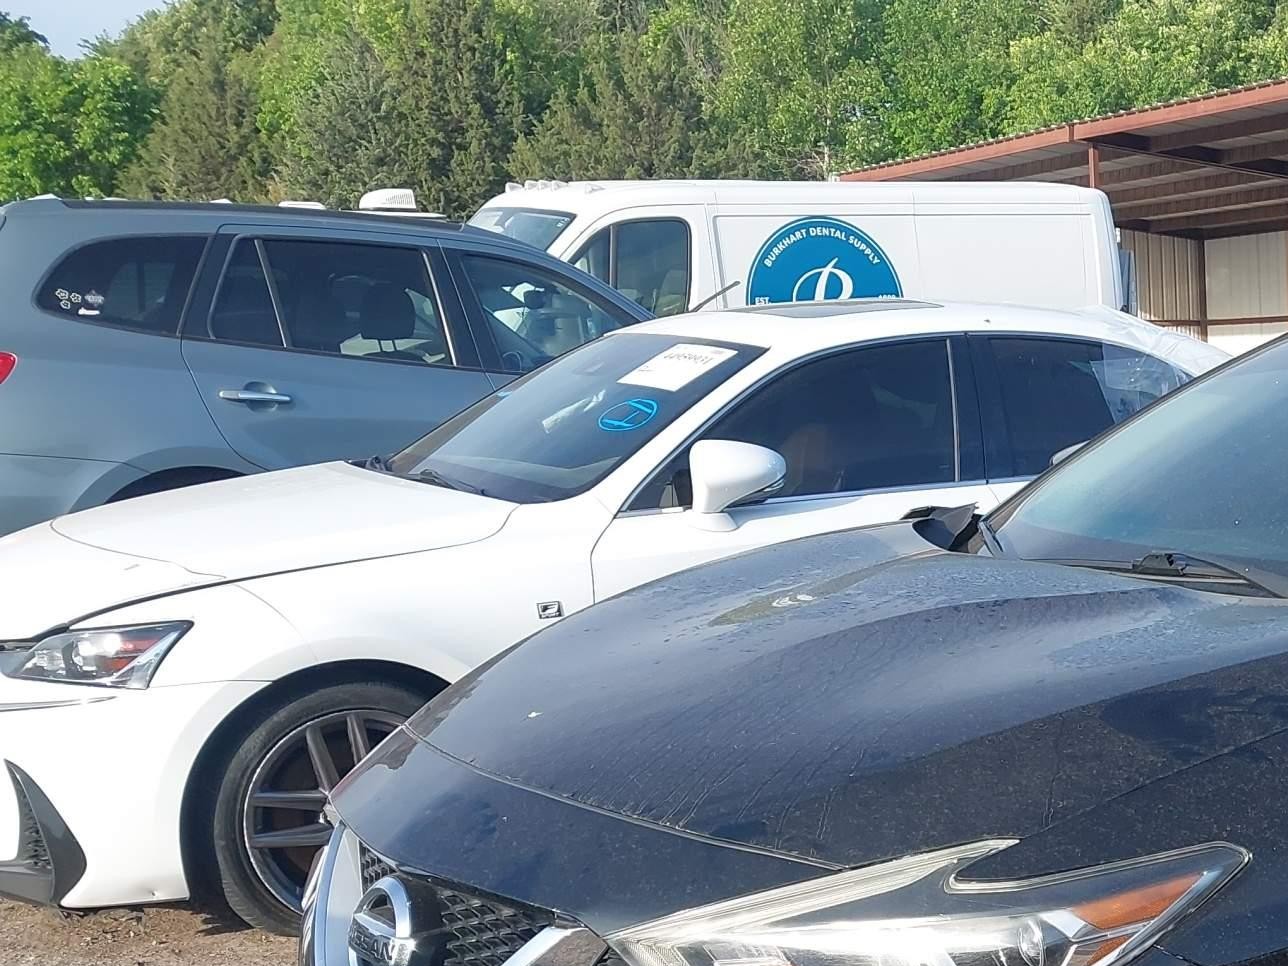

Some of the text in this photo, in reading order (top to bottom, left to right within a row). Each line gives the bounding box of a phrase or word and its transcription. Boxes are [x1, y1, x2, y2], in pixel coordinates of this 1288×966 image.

[764, 227, 881, 267] BURKHART DENTAL SUPPLY
